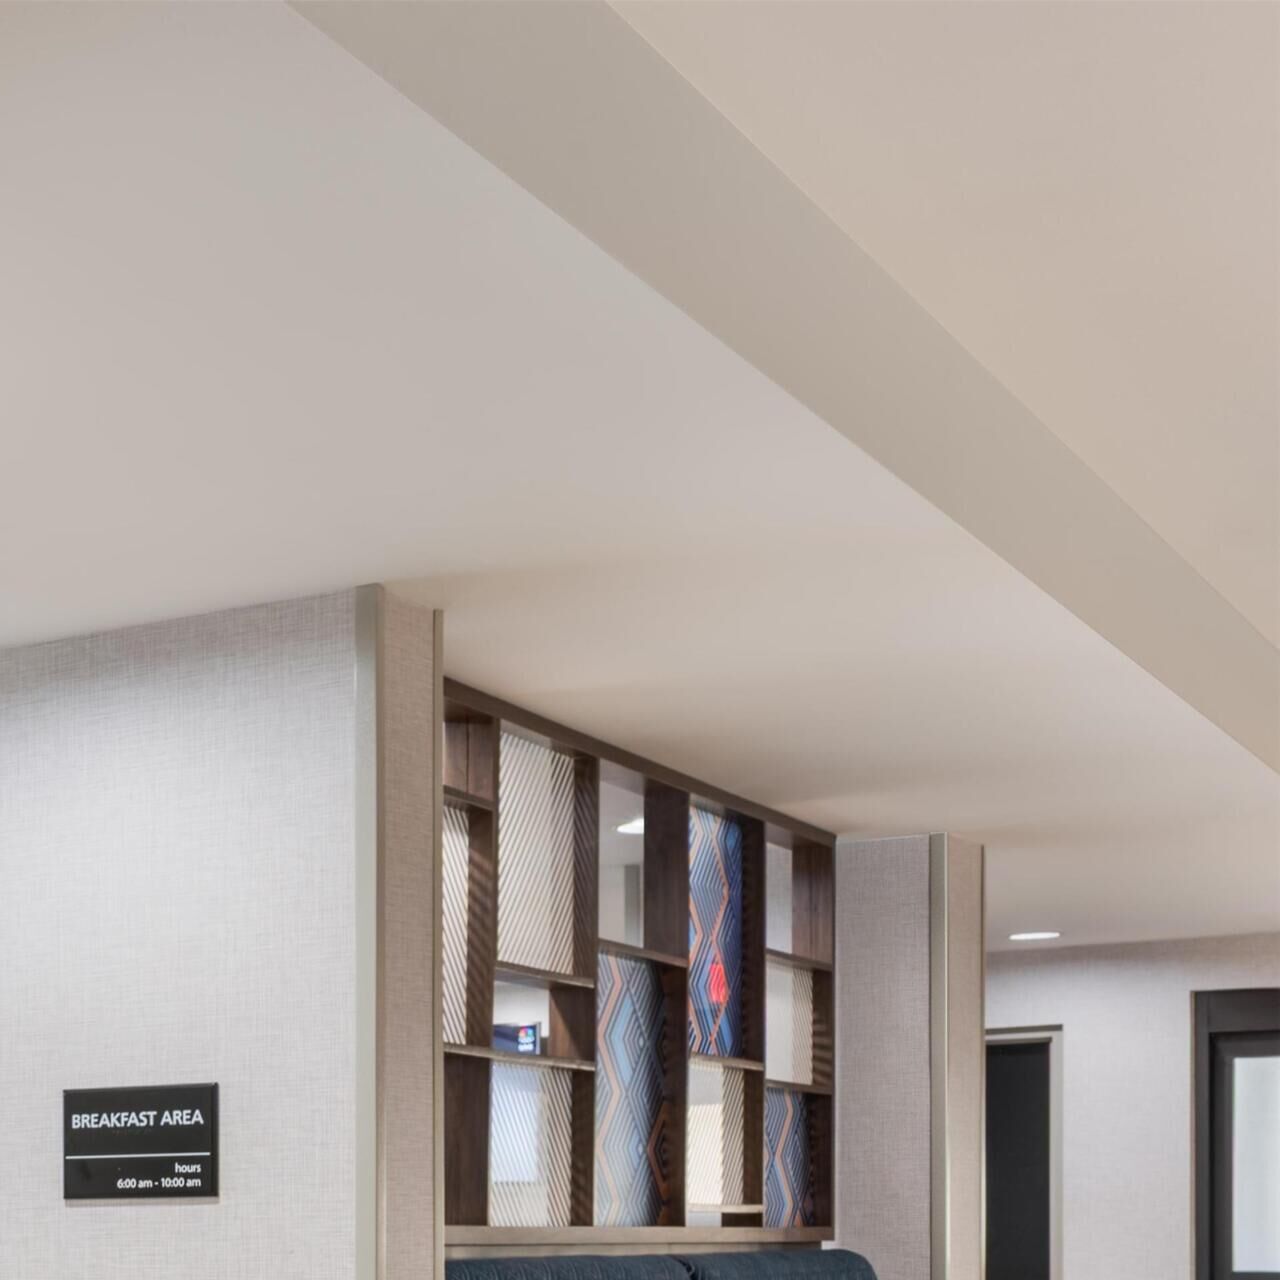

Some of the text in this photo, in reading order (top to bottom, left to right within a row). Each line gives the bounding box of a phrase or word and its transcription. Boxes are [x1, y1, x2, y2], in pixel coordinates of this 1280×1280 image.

[71, 1109, 204, 1129] BREAKFAST AREA
[175, 1162, 201, 1173] hours
[117, 1178, 136, 1188] 6:00
[161, 1177, 184, 1187] 10:00
[186, 1178, 201, 1187] am
